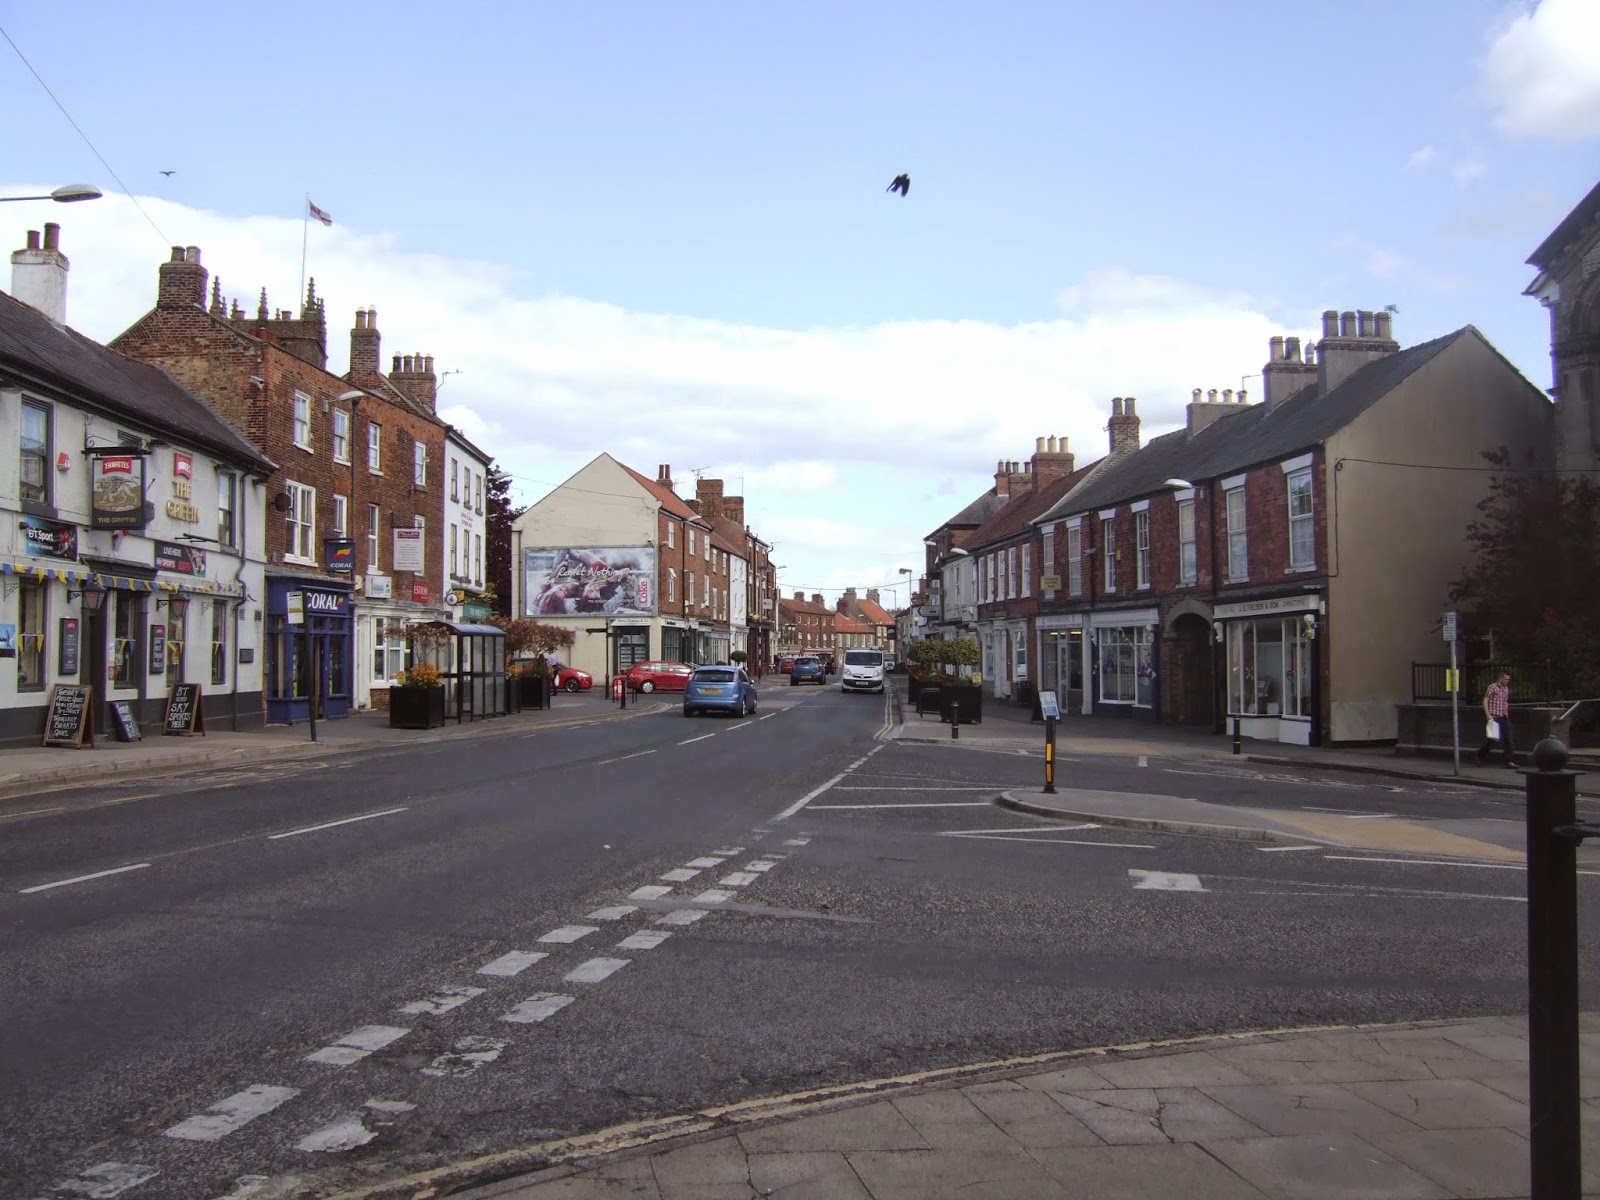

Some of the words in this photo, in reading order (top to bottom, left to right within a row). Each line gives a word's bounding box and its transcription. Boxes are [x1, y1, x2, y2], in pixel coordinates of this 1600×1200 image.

[172, 480, 192, 499] THE
[166, 500, 200, 523] GRIFFIN
[110, 516, 137, 524] GRIFFIN
[28, 528, 38, 539] BT
[38, 530, 54, 542] Sport
[639, 580, 648, 604] Coke
[176, 686, 190, 697] BT
[170, 702, 190, 713] SKY
[168, 712, 192, 721] SPORTS
[171, 720, 186, 729] HERE
[53, 729, 70, 738] QUIZ
